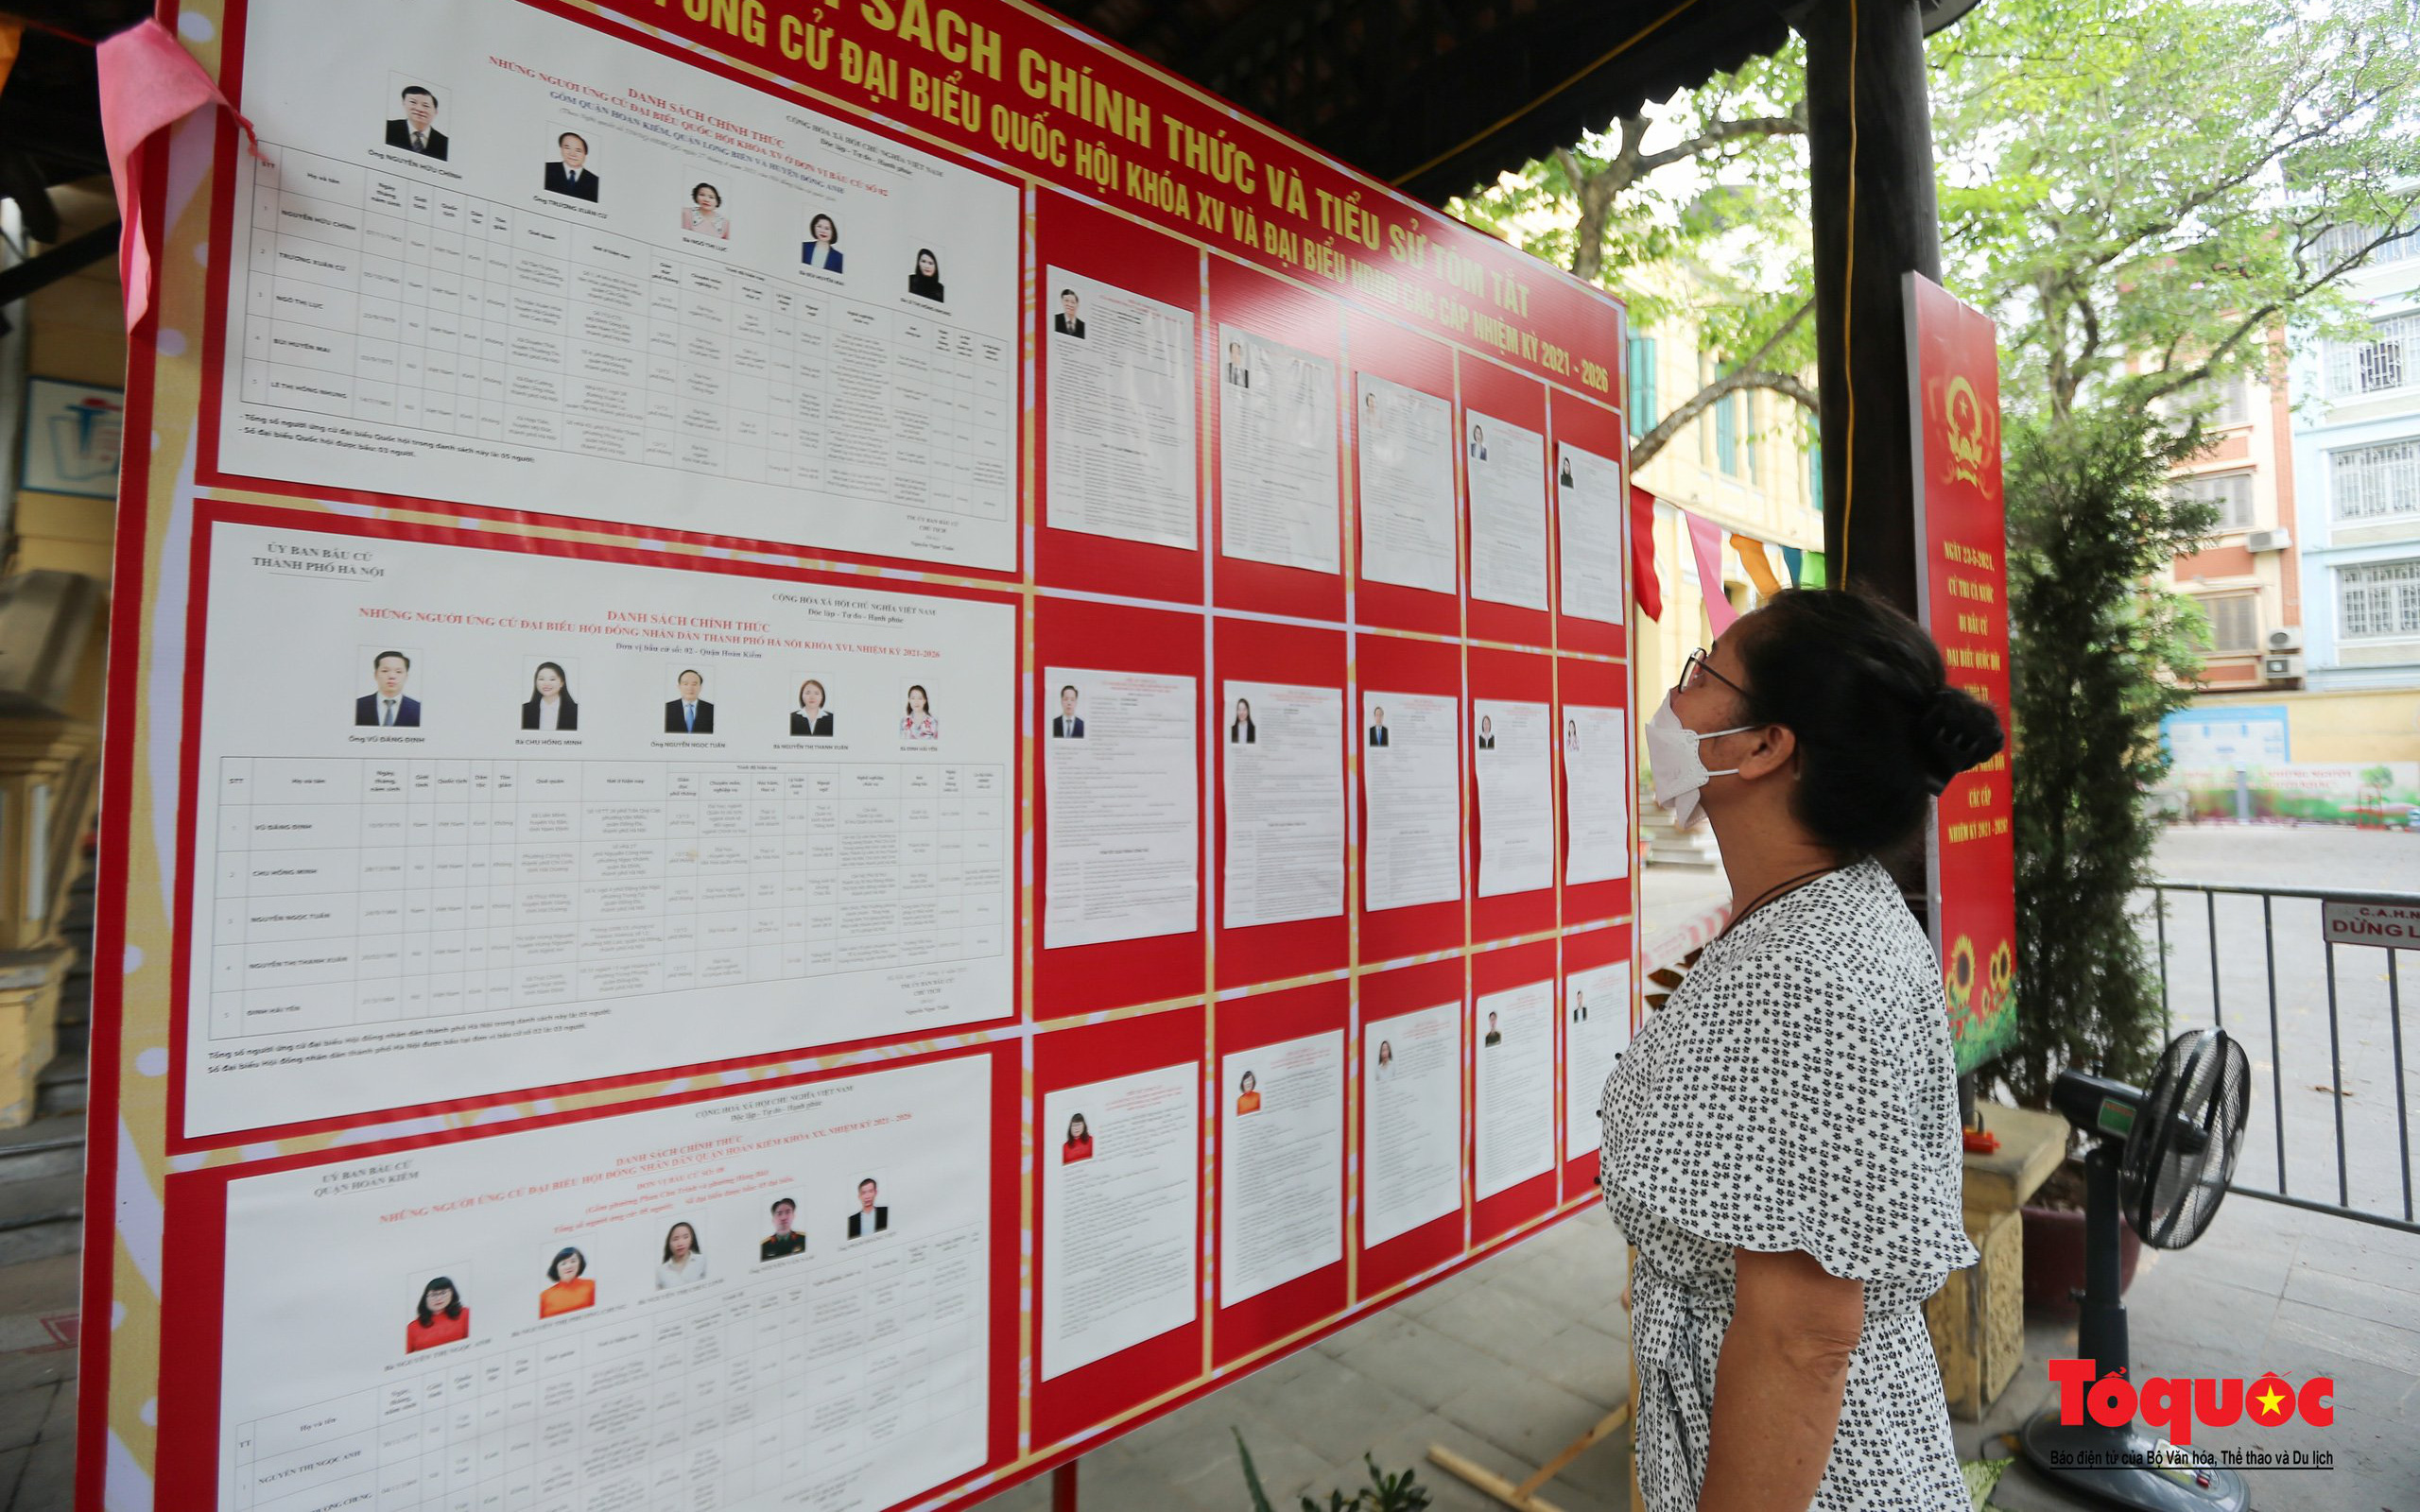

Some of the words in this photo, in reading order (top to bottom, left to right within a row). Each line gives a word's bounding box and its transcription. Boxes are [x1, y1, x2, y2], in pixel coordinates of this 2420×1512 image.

[628, 88, 666, 109] DANH
[1017, 47, 1151, 148] CHÍNH
[1163, 114, 1255, 194] THỨC
[1265, 163, 1308, 220] VÀ
[1315, 188, 1380, 251] TIỂU
[1389, 217, 1427, 270] SỬ
[1432, 243, 1485, 299] TÓM
[1491, 270, 1529, 318] TẮT
[779, 8, 835, 71] CỬ
[839, 38, 898, 103] ĐẠI
[908, 67, 980, 132] BIỂU
[991, 104, 1067, 168] QUỐC
[1075, 138, 1118, 193] HỘI
[1126, 161, 1190, 221] KHÓA
[1196, 191, 1225, 234] XV
[1231, 205, 1259, 249] VÀ
[1264, 220, 1298, 267] ĐẠI
[1303, 236, 1346, 284] BIỂU
[1473, 311, 1519, 354] NHIỆM
[1522, 332, 1539, 363] KỲ
[1542, 341, 1570, 377] 2021
[1582, 359, 1609, 393] 2026
[290, 546, 319, 557] BAN
[607, 610, 647, 624] DANH
[650, 611, 685, 627] SÁCH
[690, 616, 731, 630] CHÍNH
[2332, 917, 2403, 937] DỪNG
